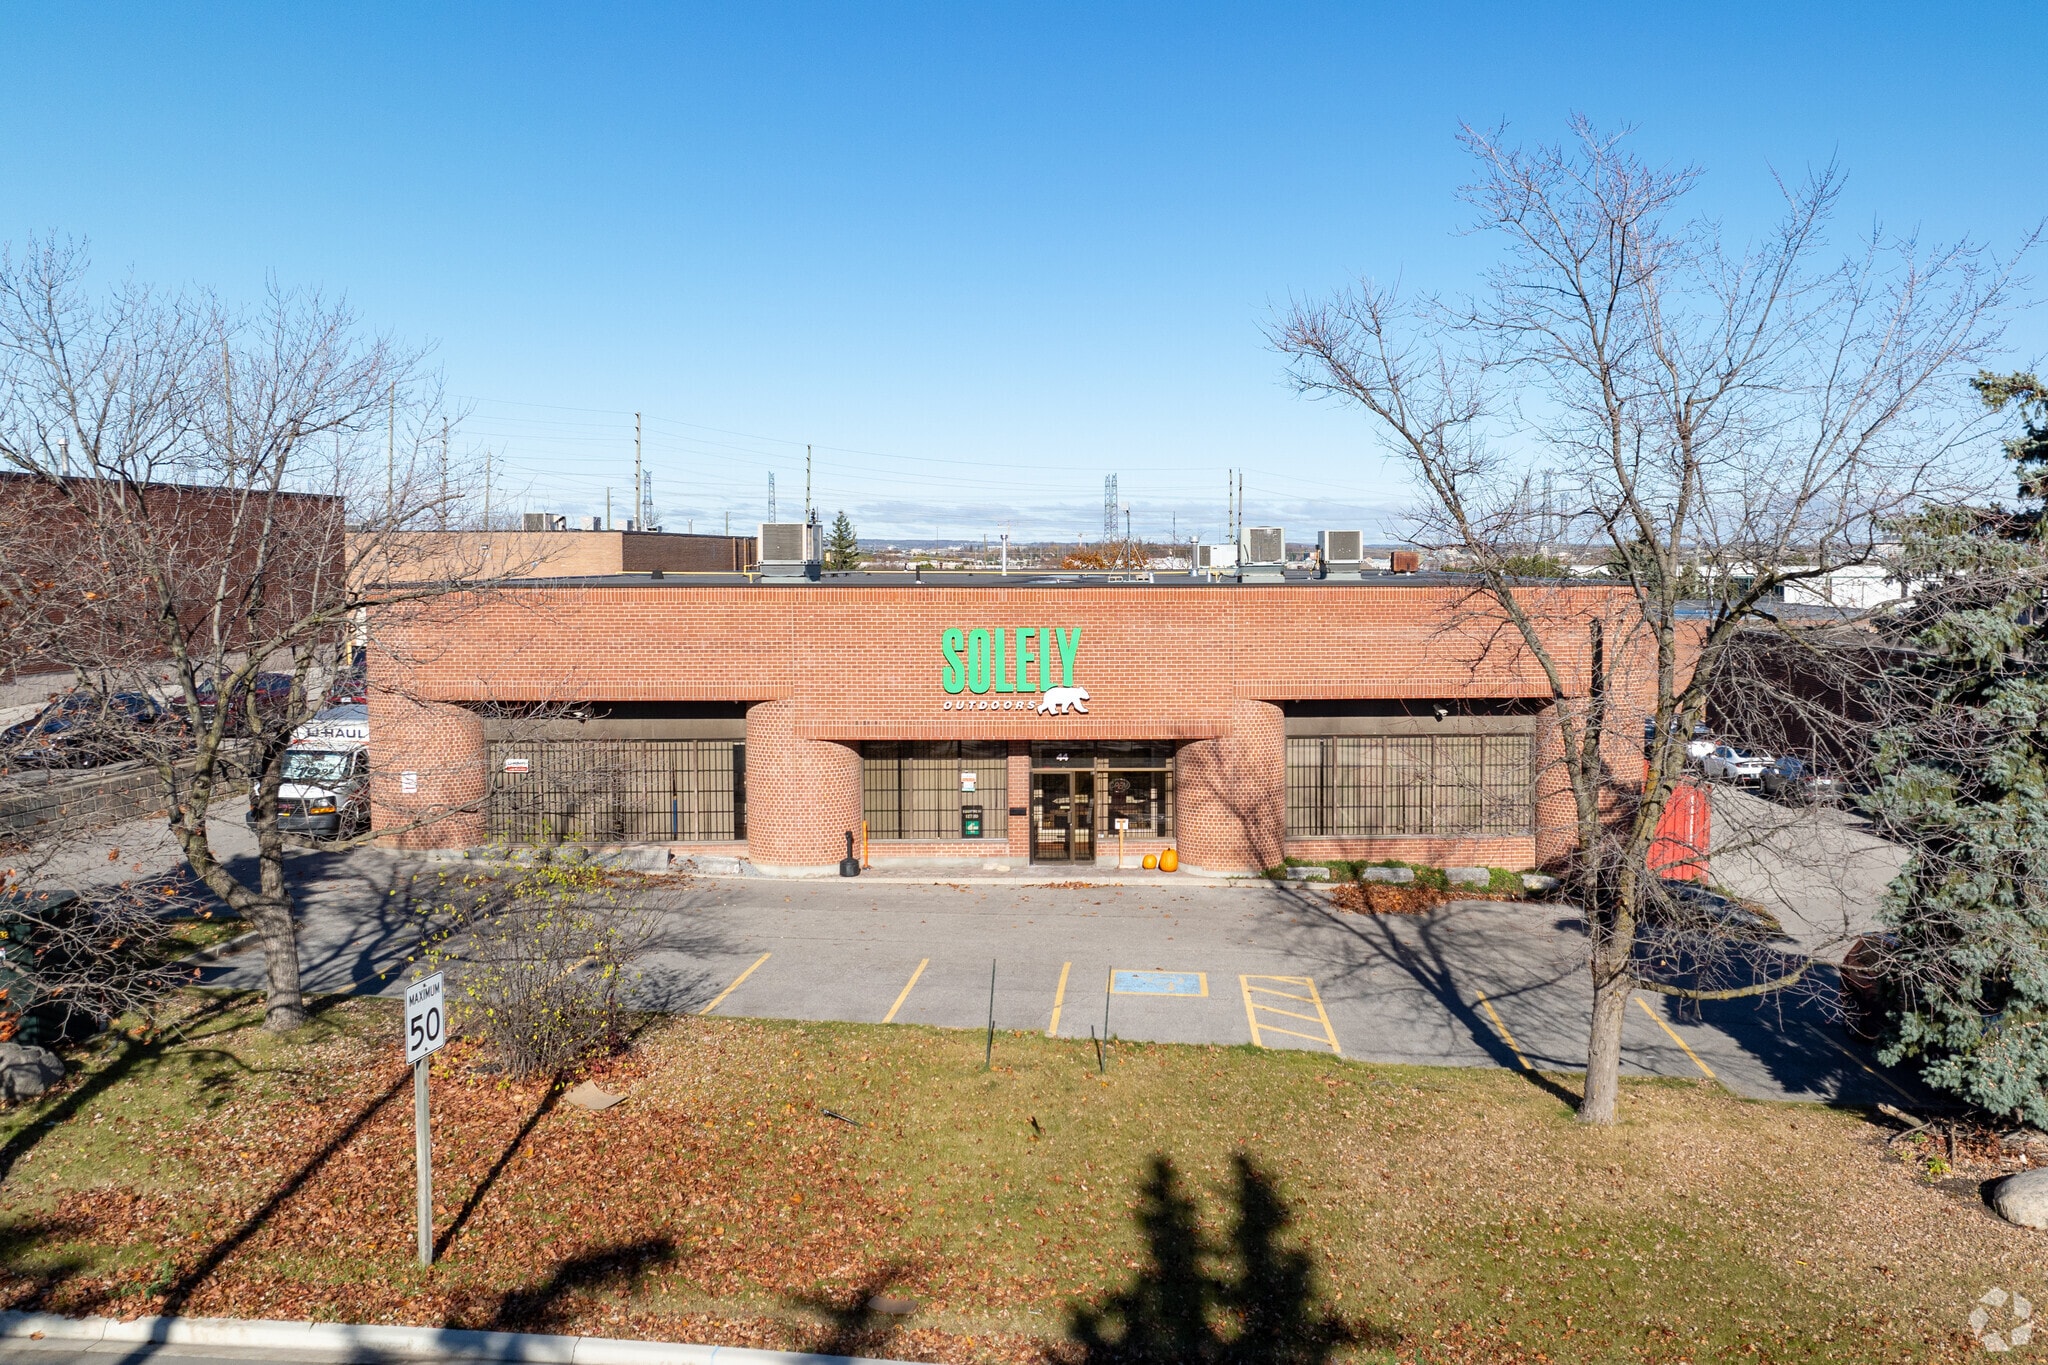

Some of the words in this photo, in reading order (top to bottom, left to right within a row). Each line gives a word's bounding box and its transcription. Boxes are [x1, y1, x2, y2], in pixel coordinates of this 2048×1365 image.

[942, 627, 1082, 694] SOLELY
[943, 700, 1037, 710] OUTDOORS
[307, 728, 366, 739] U-HAUL
[1056, 753, 1069, 761] 44
[409, 982, 440, 1007] MAXIMUM
[411, 1007, 440, 1052] 50
